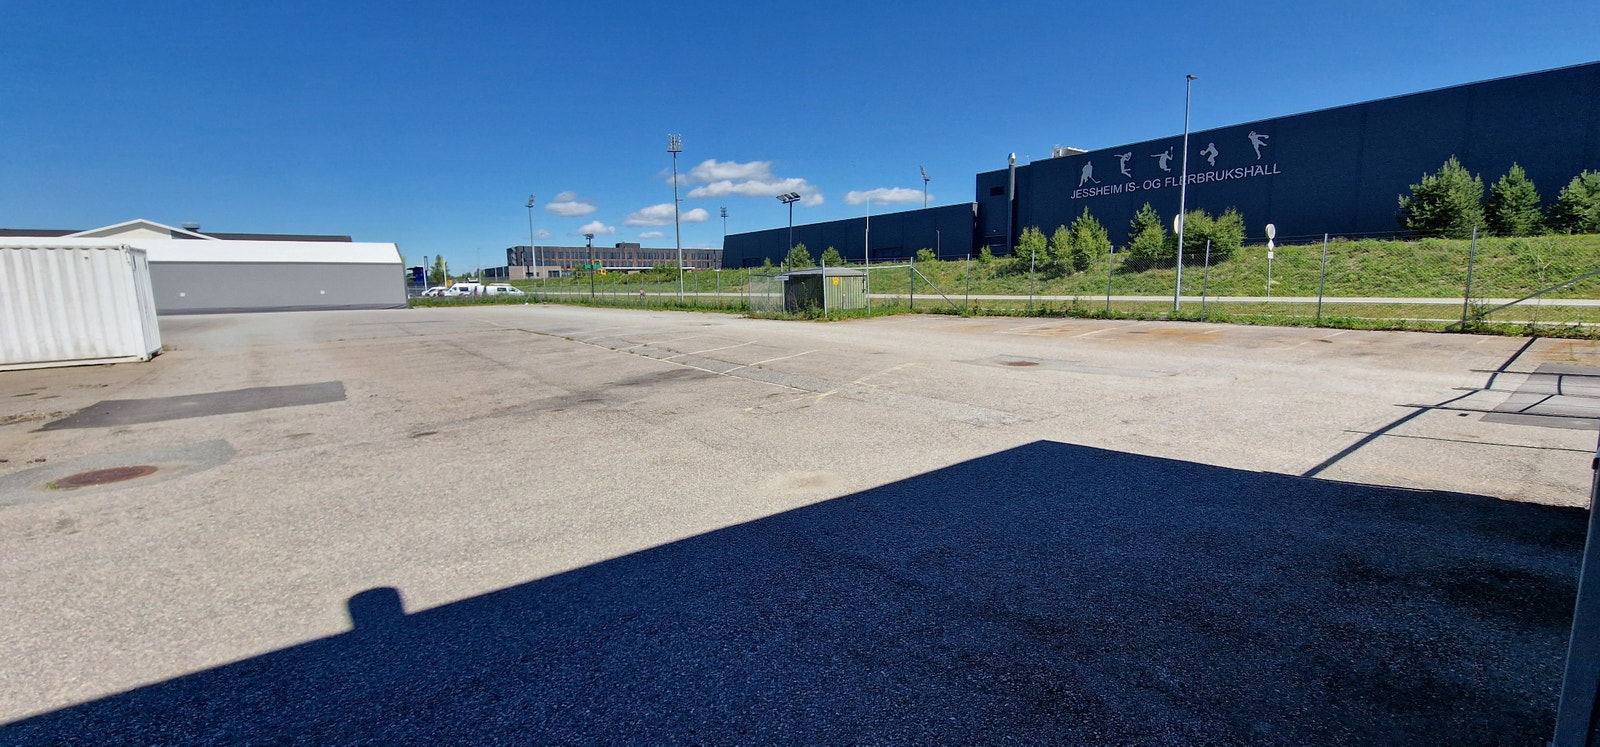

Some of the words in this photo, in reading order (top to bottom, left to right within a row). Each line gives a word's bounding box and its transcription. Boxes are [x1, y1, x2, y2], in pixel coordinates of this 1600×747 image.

[1070, 183, 1122, 200] JESSHEIM
[1125, 182, 1140, 192] IS-
[1143, 179, 1161, 190] OG
